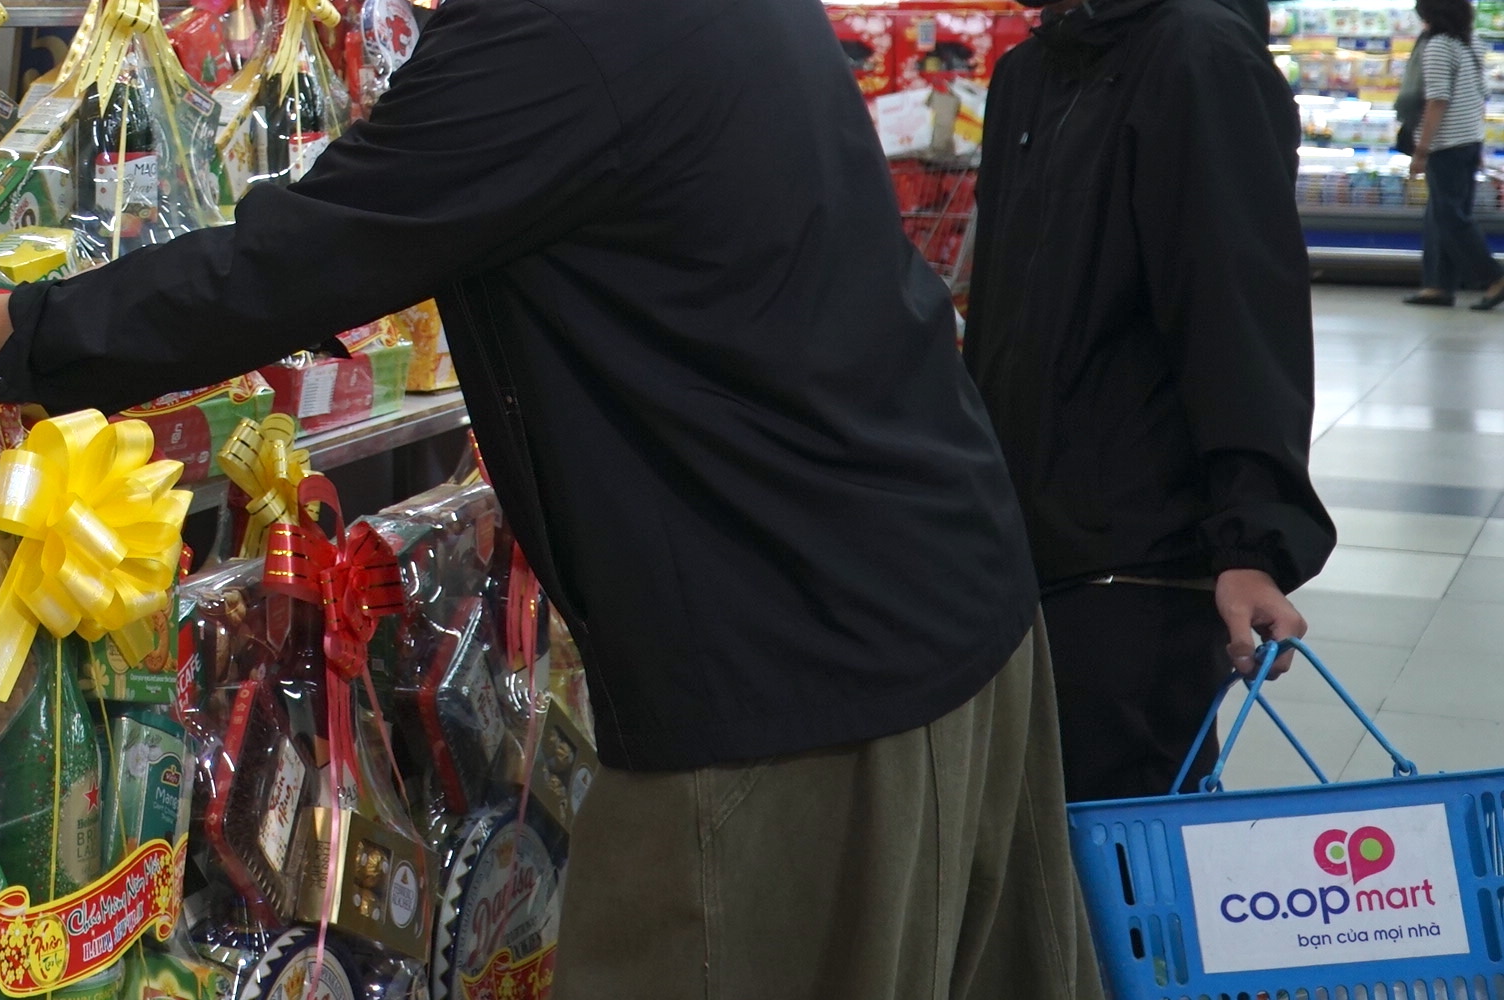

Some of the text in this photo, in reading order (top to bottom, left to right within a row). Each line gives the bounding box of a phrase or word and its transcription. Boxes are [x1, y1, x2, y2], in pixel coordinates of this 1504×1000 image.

[1297, 922, 1441, 951] bạn của mọi nhà
